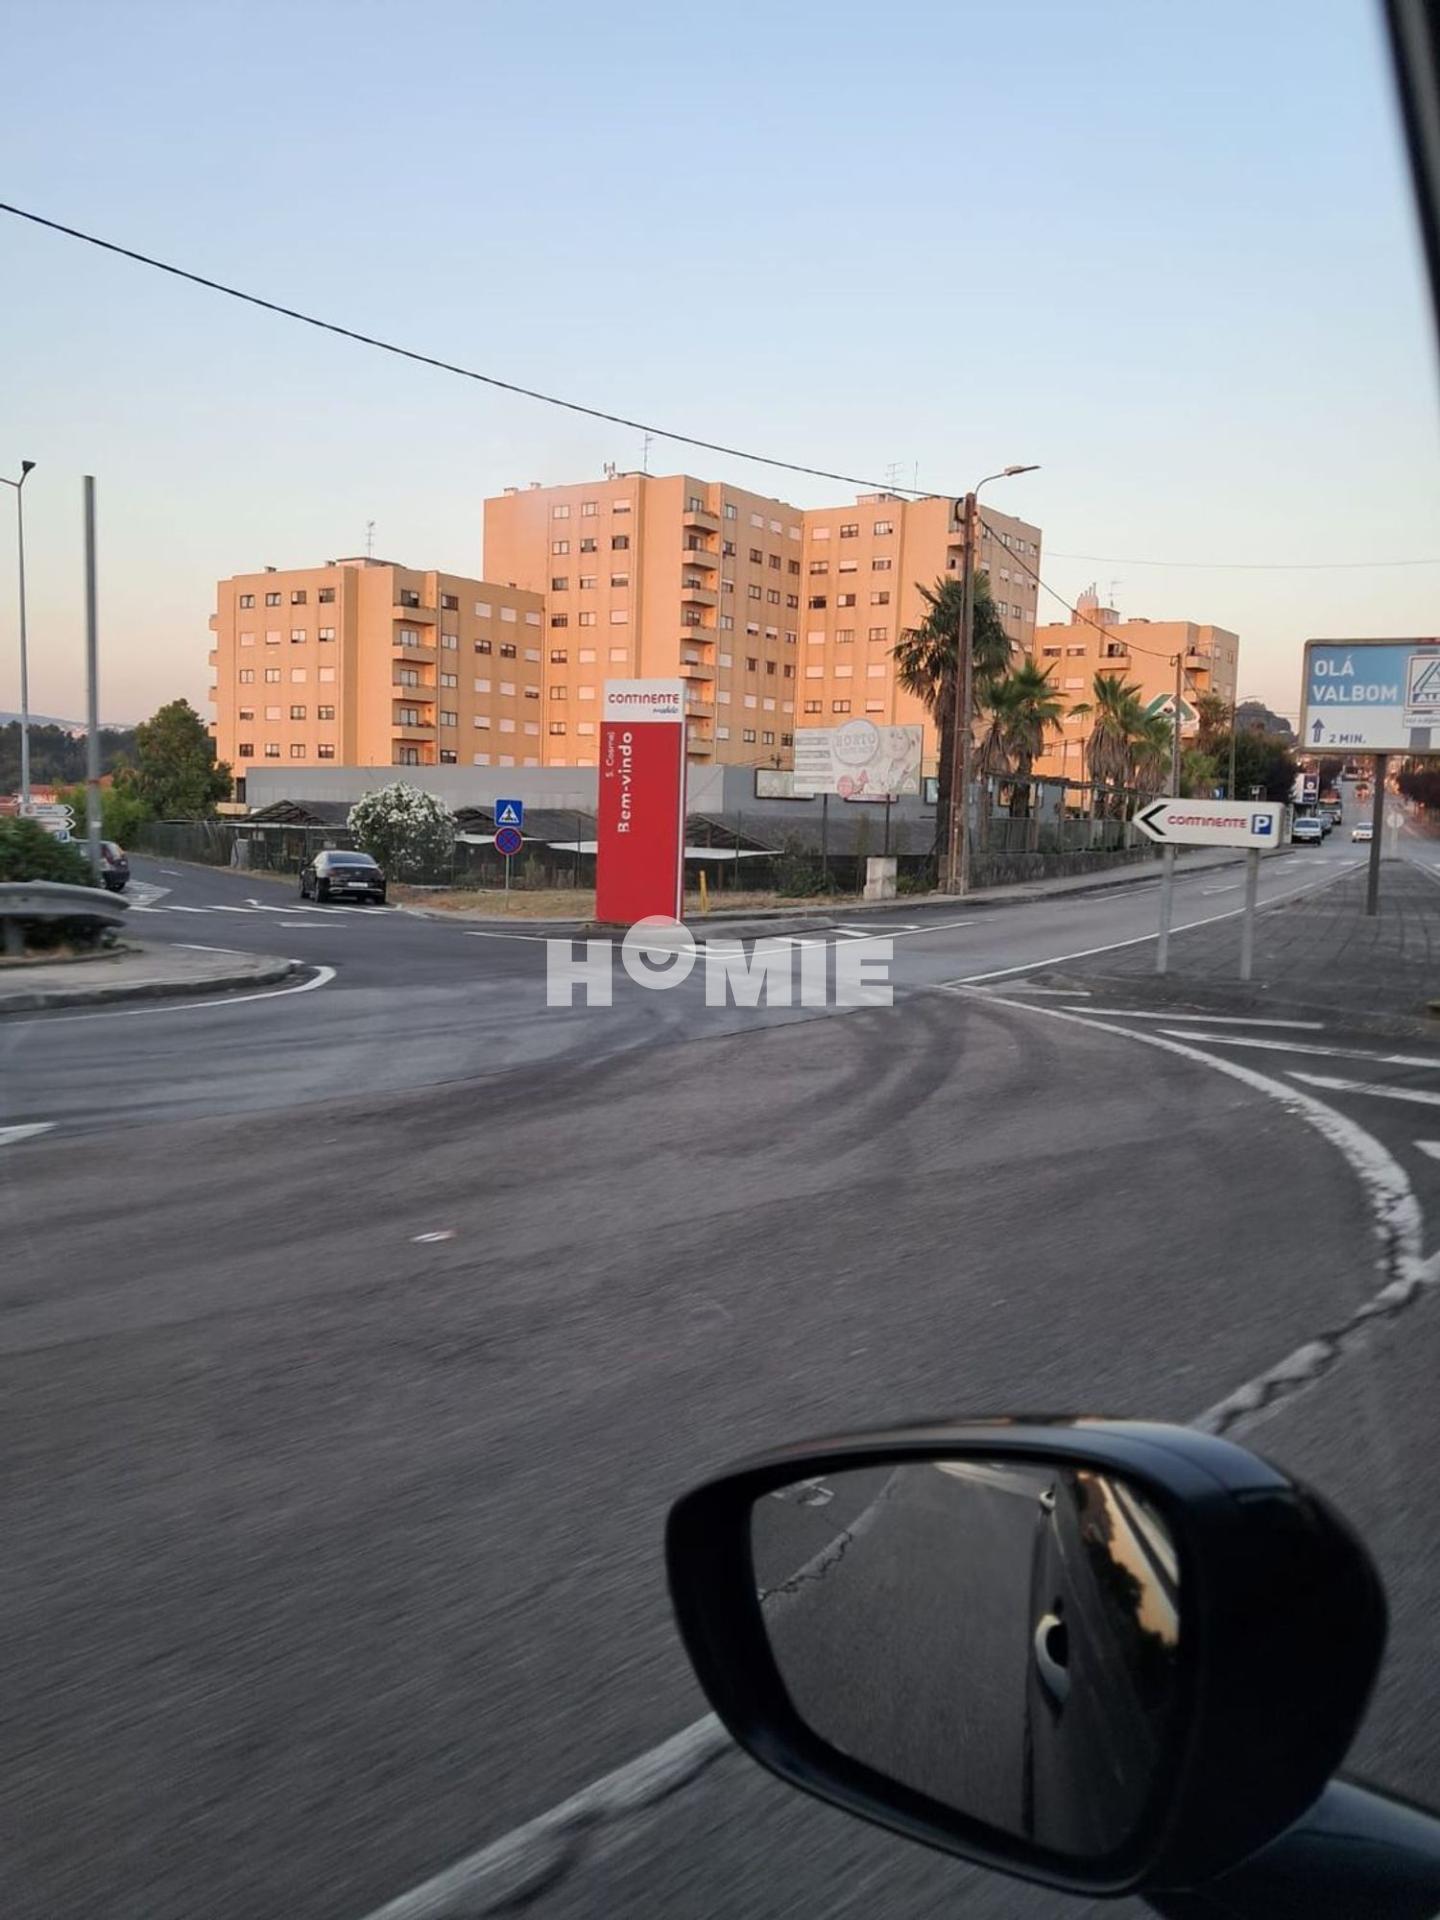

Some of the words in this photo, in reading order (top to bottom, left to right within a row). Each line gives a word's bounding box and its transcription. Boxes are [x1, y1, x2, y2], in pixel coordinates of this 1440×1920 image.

[1314, 654, 1355, 677] OLÁ
[608, 693, 679, 704] CONTINENTE
[1312, 684, 1398, 702] VALBOM
[1329, 734, 1336, 744] 2
[1339, 733, 1367, 744] MIN.
[617, 732, 633, 833] Bem-vindo
[1167, 815, 1249, 829] CONTINENTE
[1254, 816, 1269, 833] P
